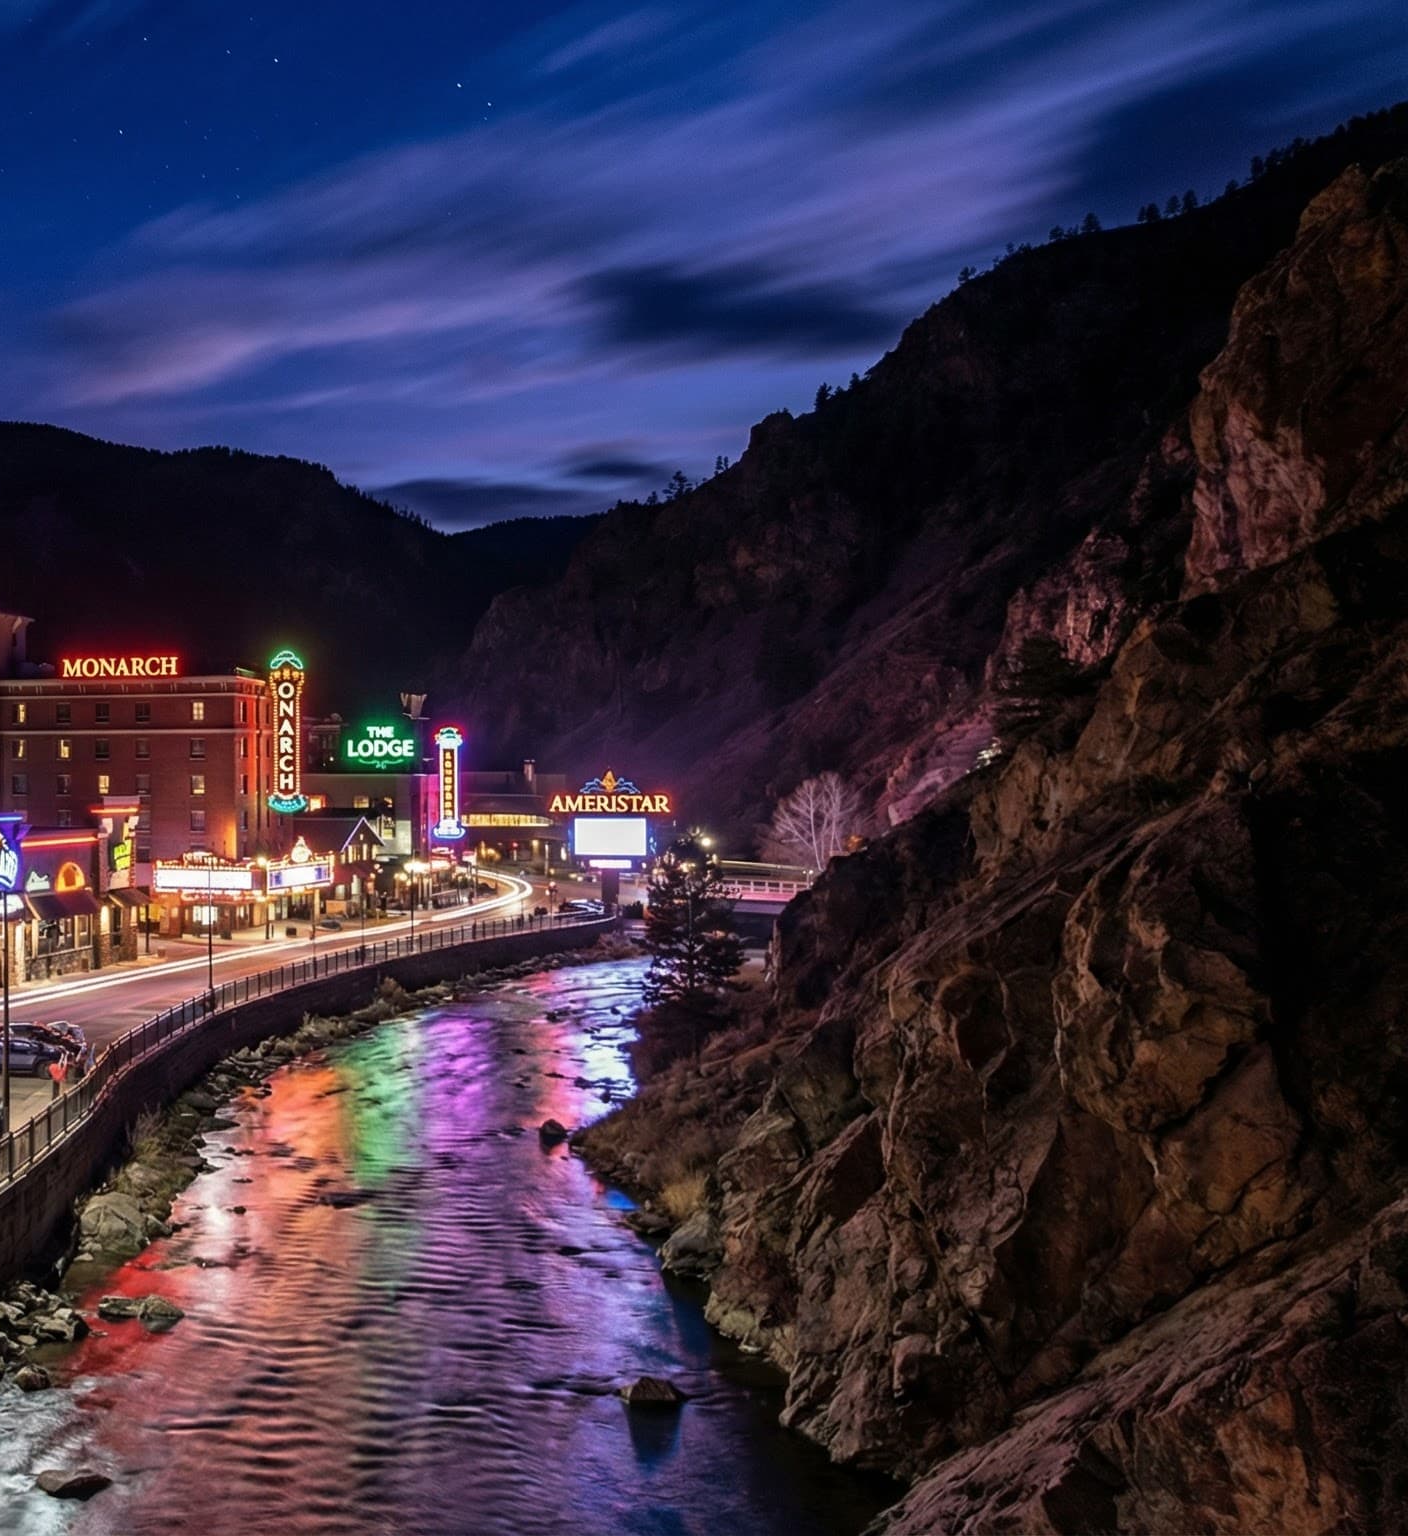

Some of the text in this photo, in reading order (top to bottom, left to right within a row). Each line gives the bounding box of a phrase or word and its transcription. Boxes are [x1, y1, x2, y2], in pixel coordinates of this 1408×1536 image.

[63, 657, 178, 677] MONARCH
[366, 726, 394, 738] THE
[347, 739, 414, 757] LODGE
[549, 795, 671, 813] AMERISTAR
